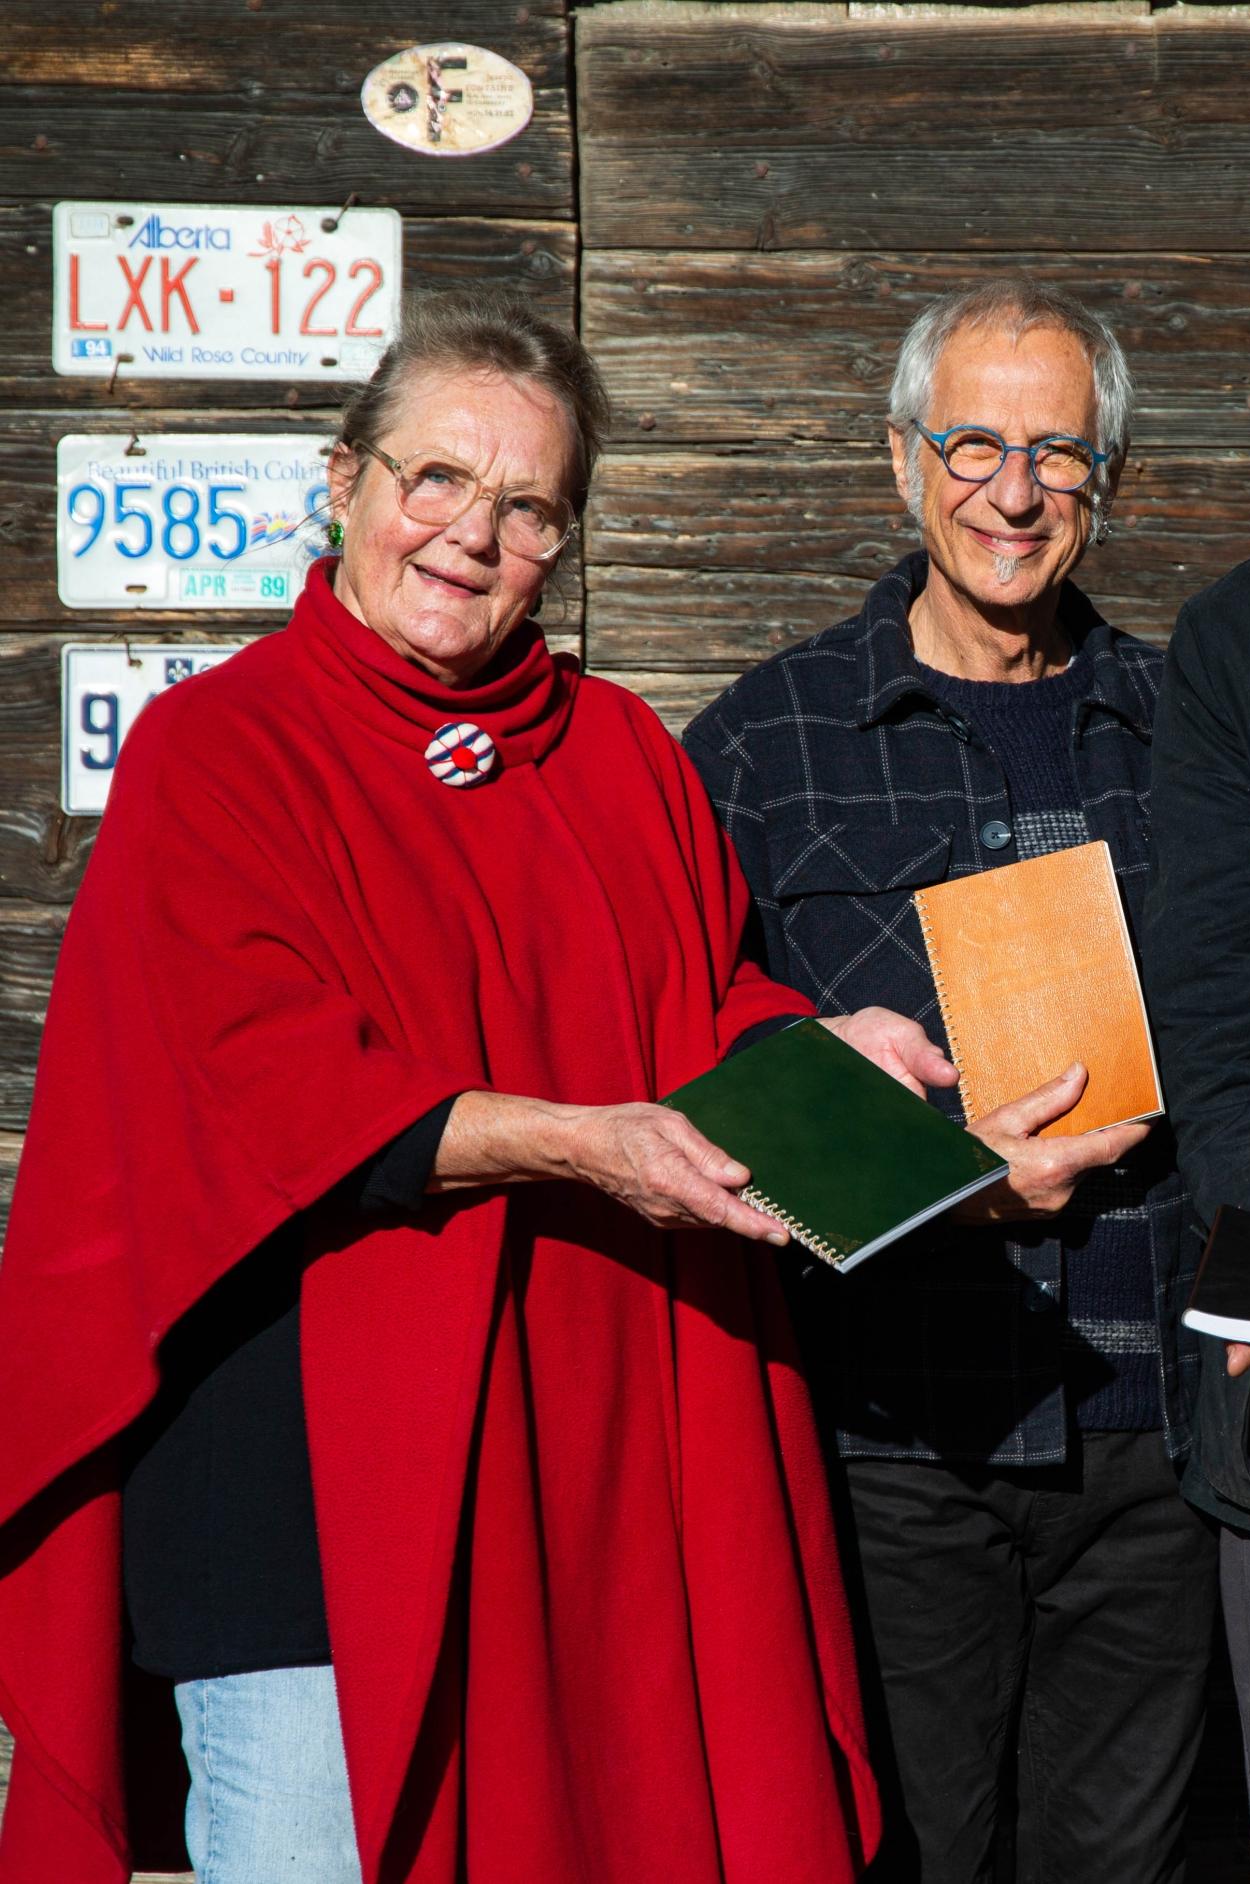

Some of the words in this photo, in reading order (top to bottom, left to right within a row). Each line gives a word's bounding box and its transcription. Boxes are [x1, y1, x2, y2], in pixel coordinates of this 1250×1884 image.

[128, 213, 231, 250] Alberta
[85, 339, 107, 356] 94
[143, 346, 182, 364] Wild
[192, 347, 234, 364] Rose
[241, 347, 309, 366] Country
[87, 458, 183, 481] Beautiful
[191, 458, 258, 480] British
[68, 483, 247, 560] 9585
[184, 575, 226, 597] APR
[260, 575, 285, 598] 89
